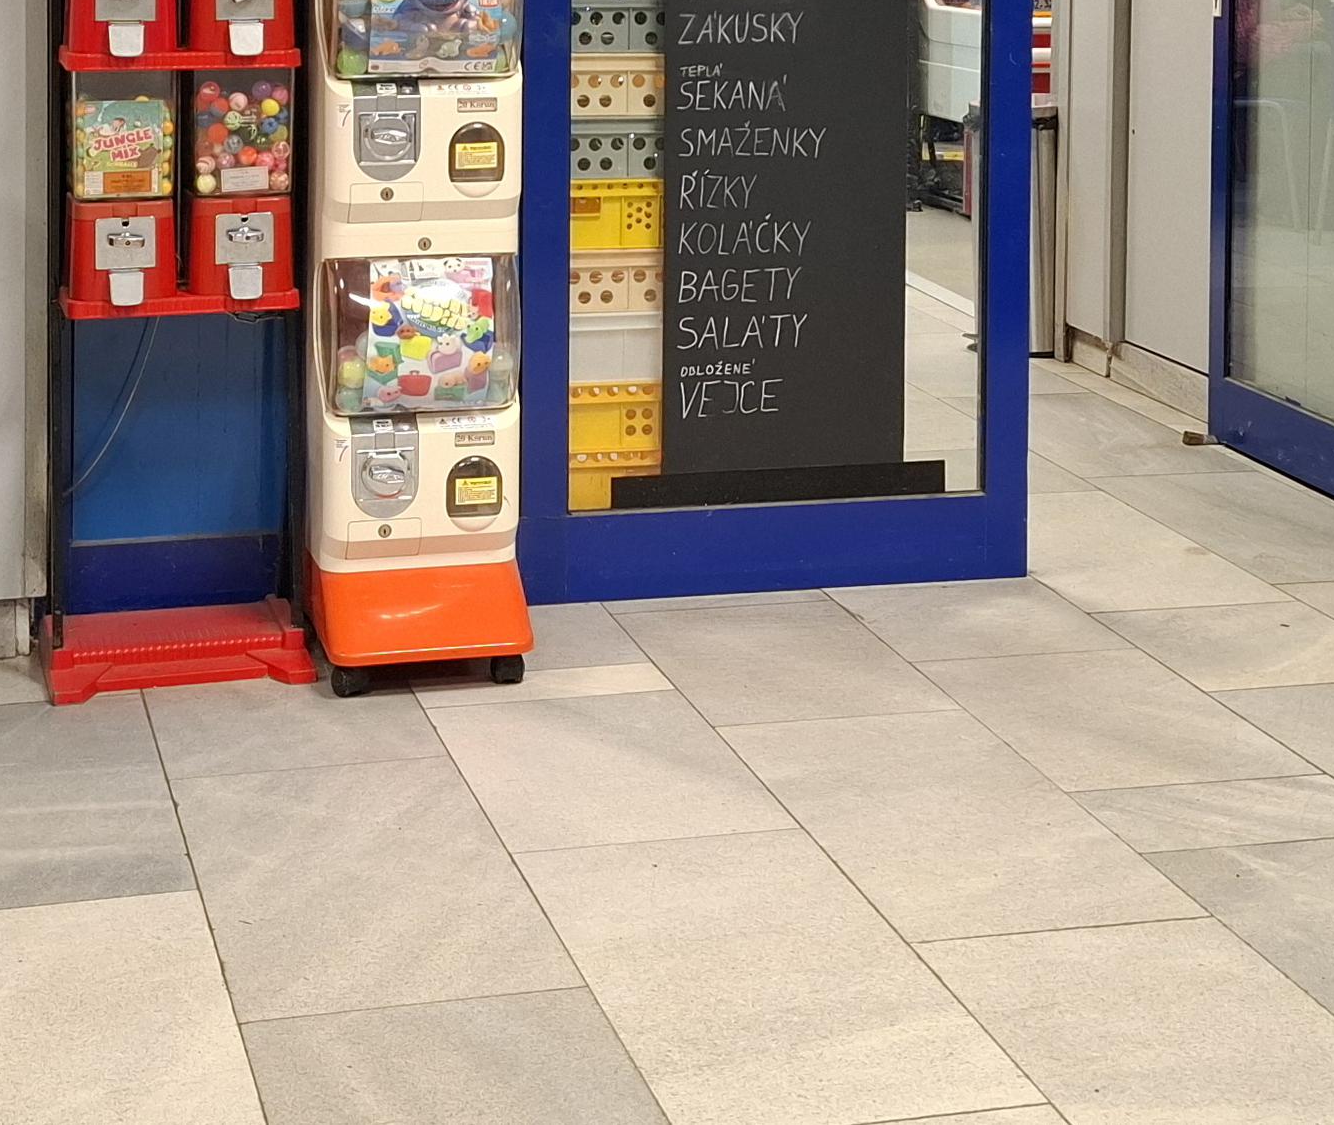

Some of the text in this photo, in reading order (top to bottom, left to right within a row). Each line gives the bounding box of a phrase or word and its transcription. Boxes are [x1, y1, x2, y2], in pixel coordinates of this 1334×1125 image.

[677, 10, 804, 45] ZÁKUSKY
[679, 62, 723, 78] TEPLÁ
[676, 74, 788, 112] SEKANÁ
[92, 127, 154, 152] JUNGLE
[109, 144, 141, 162] MIX
[678, 120, 827, 159] SMAŽENKY
[679, 168, 758, 210] ŘÍZKY
[678, 212, 812, 257] KOLÁČKY
[678, 266, 802, 304] BAGETY
[676, 313, 808, 351] SALÁTY
[679, 358, 755, 378] OBLOŽENÉ
[680, 378, 784, 420] VEJCE
